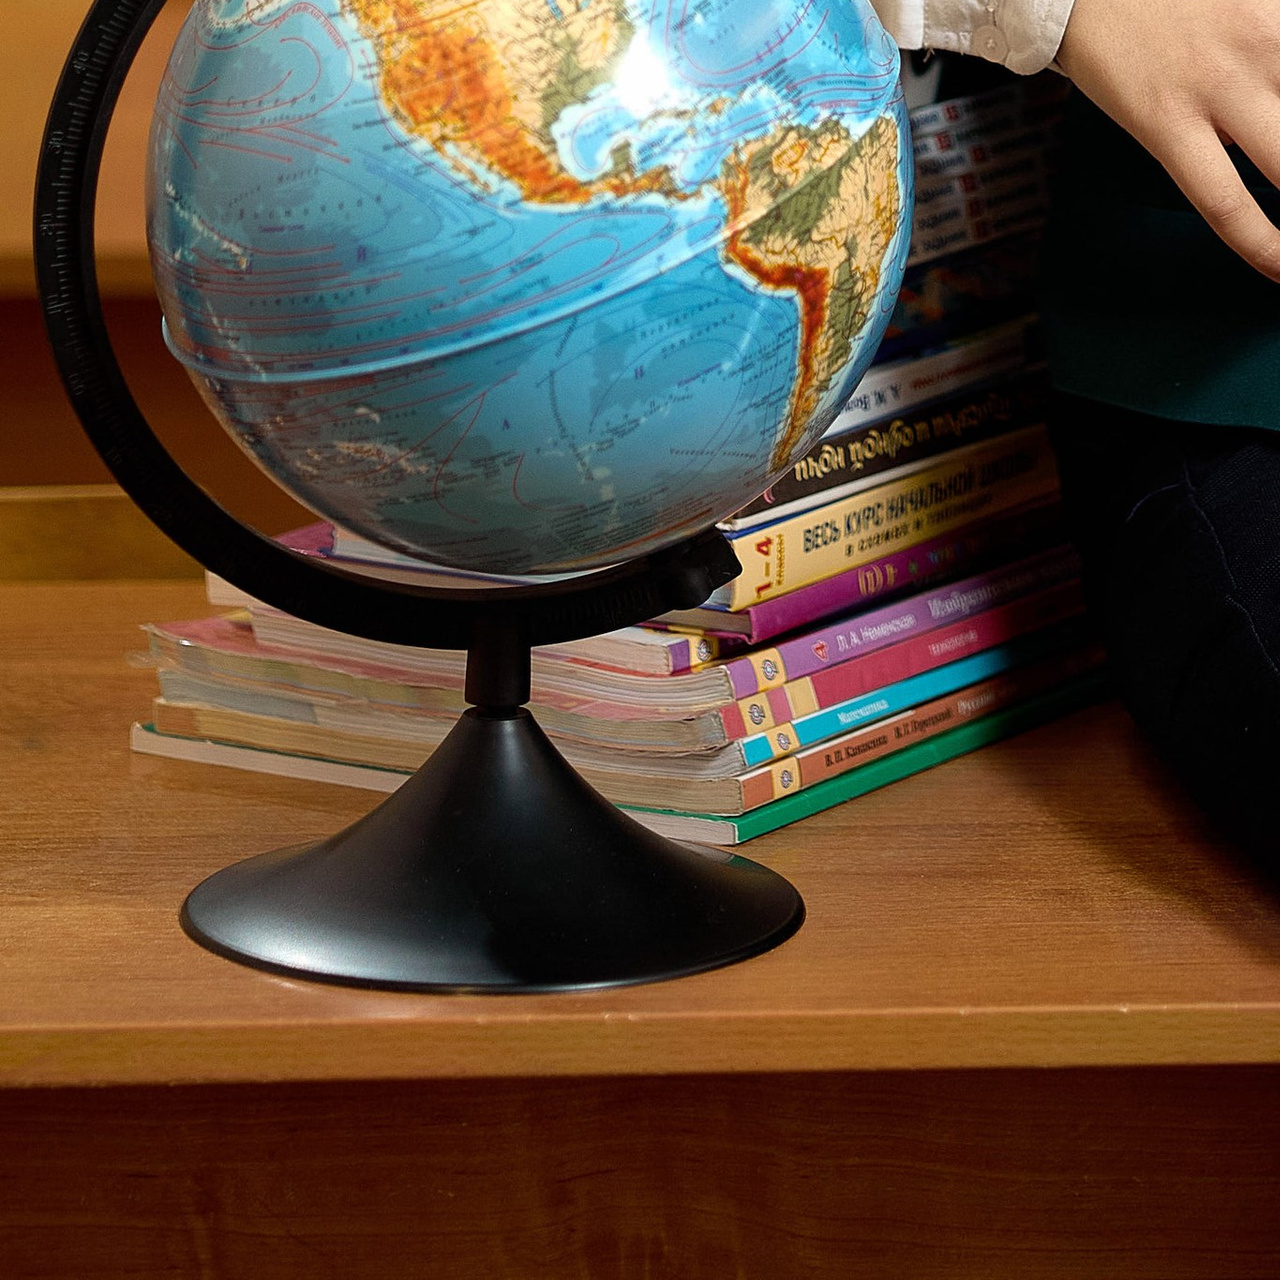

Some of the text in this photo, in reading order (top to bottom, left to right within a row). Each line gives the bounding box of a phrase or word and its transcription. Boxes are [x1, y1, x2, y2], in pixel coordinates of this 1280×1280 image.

[793, 442, 846, 482] ночи
[849, 418, 914, 472] одной
[802, 521, 842, 554] ВЕСЬ
[844, 502, 884, 537] КУРС
[886, 469, 974, 520] НАЧАЛЬНОЙ
